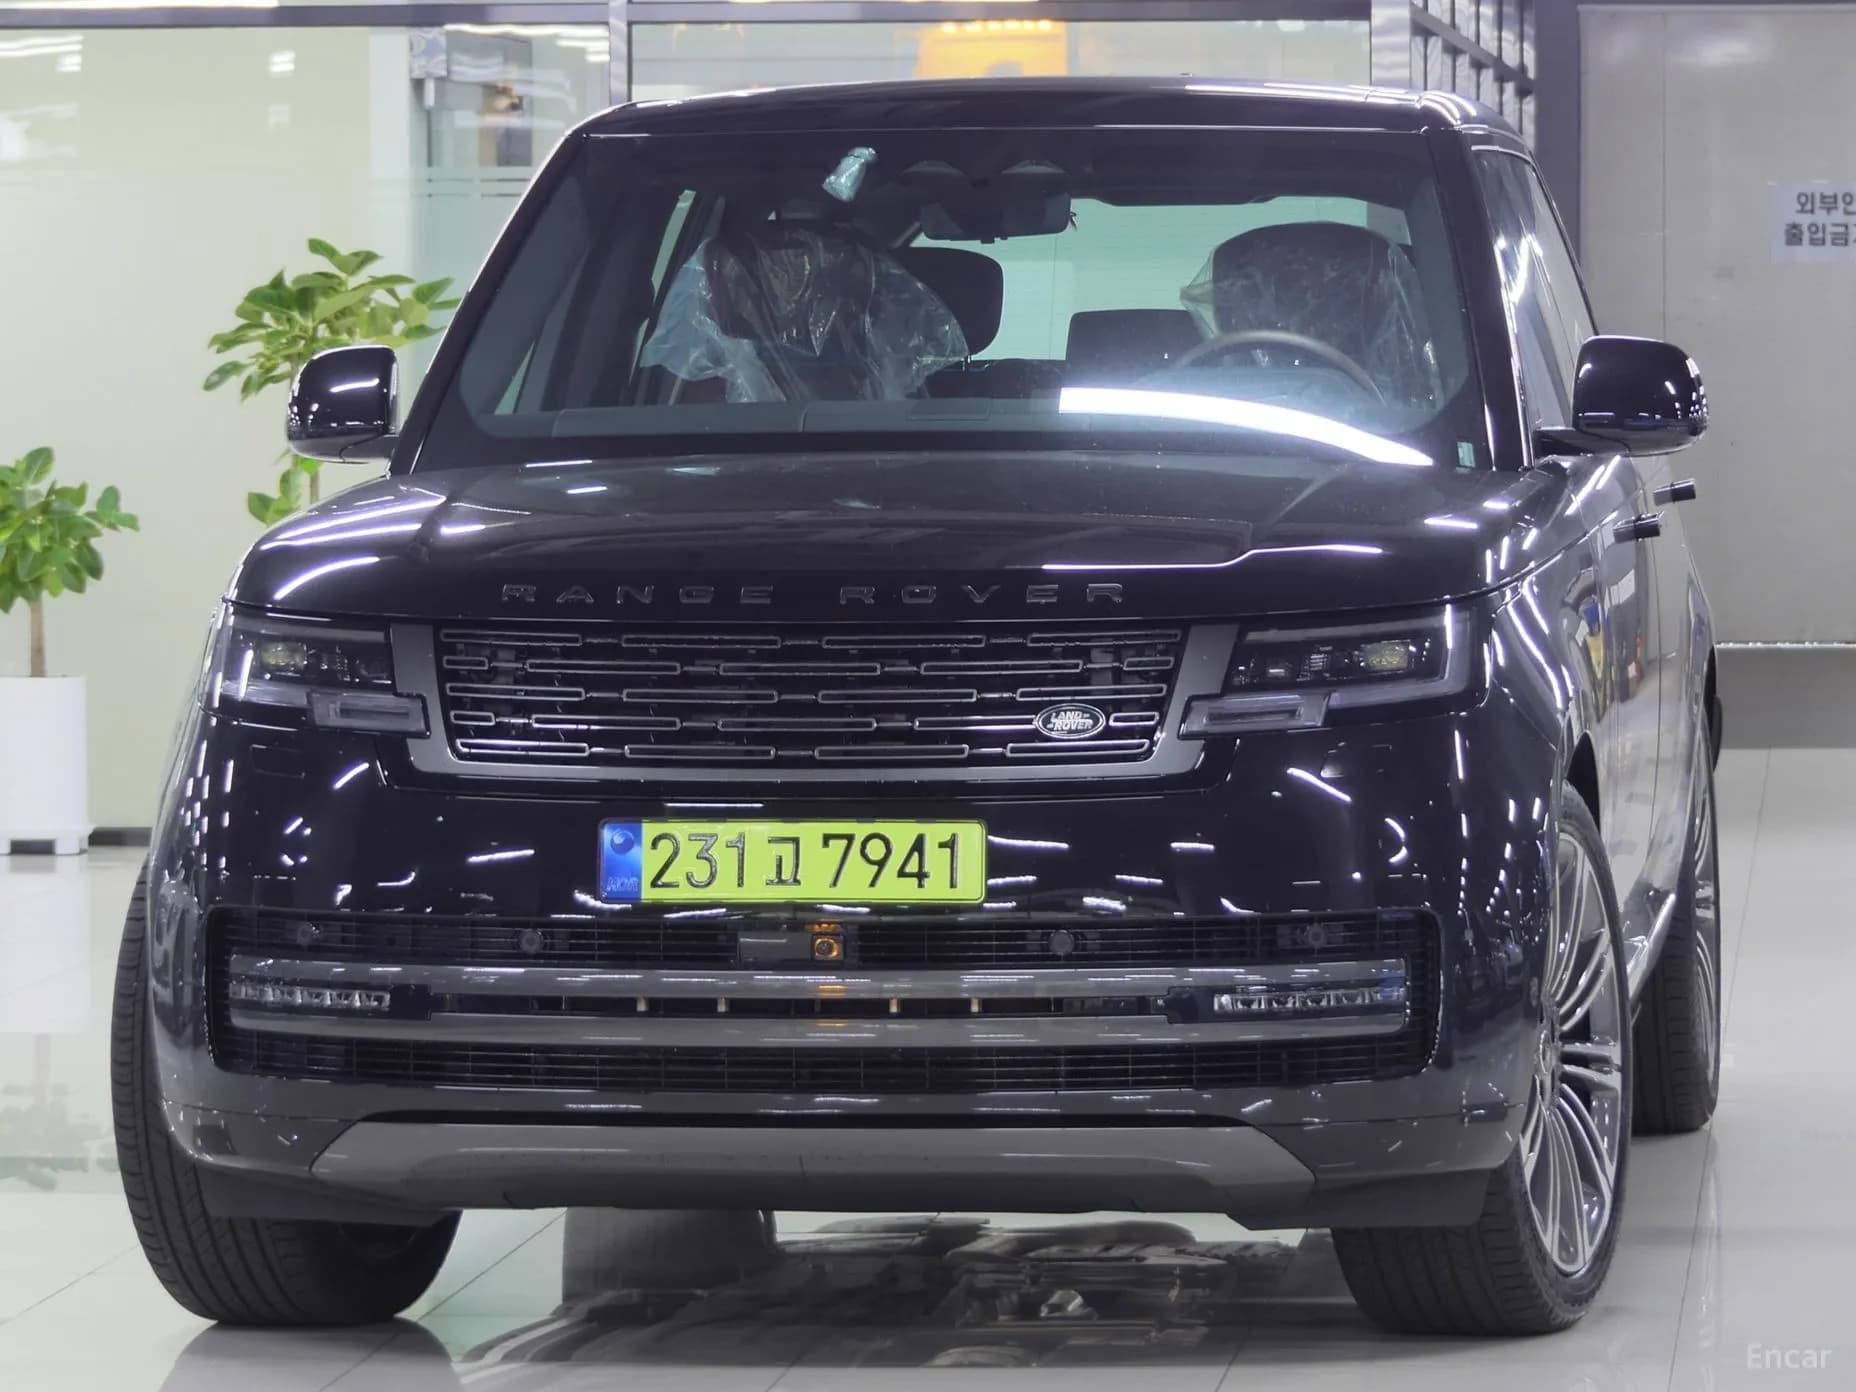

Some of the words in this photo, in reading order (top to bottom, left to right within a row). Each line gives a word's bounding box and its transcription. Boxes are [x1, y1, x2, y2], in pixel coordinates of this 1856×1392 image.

[1784, 222, 1856, 247] 출입금
[502, 583, 774, 605] RANGE
[840, 582, 1124, 605] ROVER
[1051, 710, 1083, 722] LAND
[1053, 719, 1094, 731] ROVER
[821, 831, 960, 889] 7941
